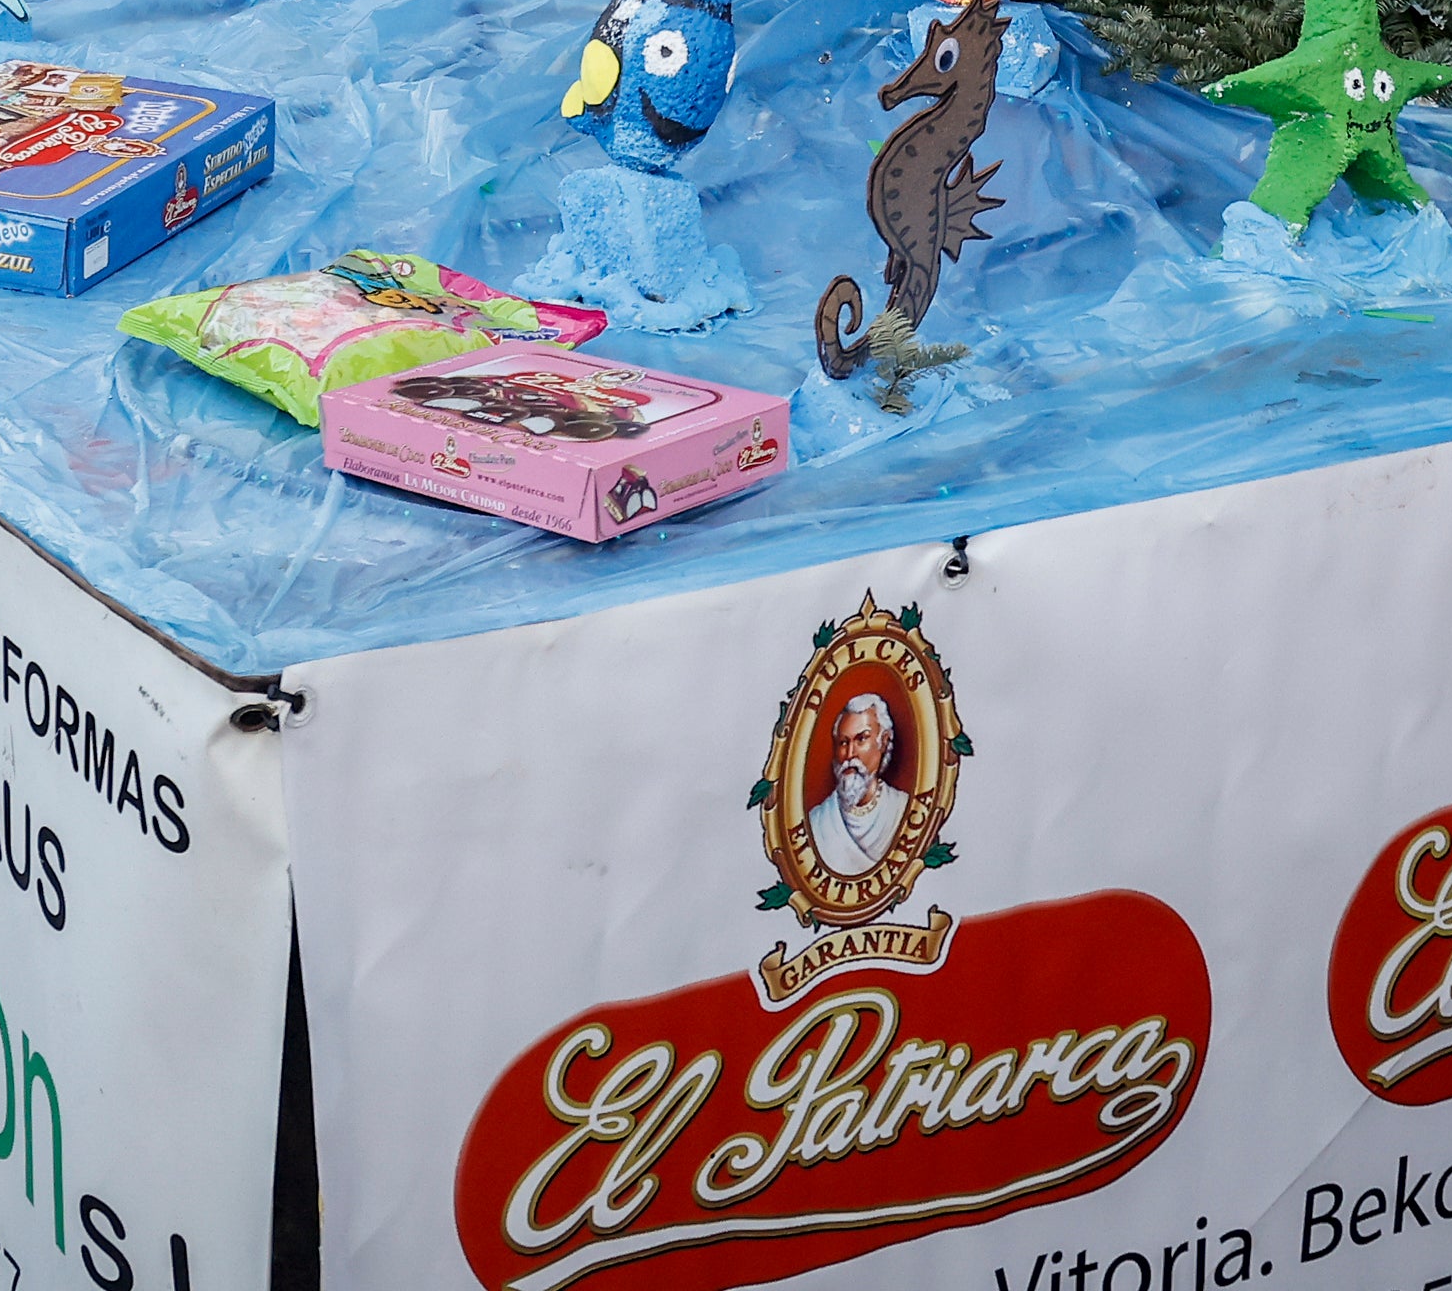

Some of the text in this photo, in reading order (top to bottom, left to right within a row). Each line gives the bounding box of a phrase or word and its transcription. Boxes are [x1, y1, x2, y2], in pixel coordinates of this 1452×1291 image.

[511, 505, 541, 524] desde
[545, 513, 572, 532] 1966
[805, 637, 927, 716] DULCES
[785, 786, 937, 906] EL PATRIARCA
[779, 931, 929, 992] GARANTIA
[500, 985, 1196, 1258] El Patriarca
